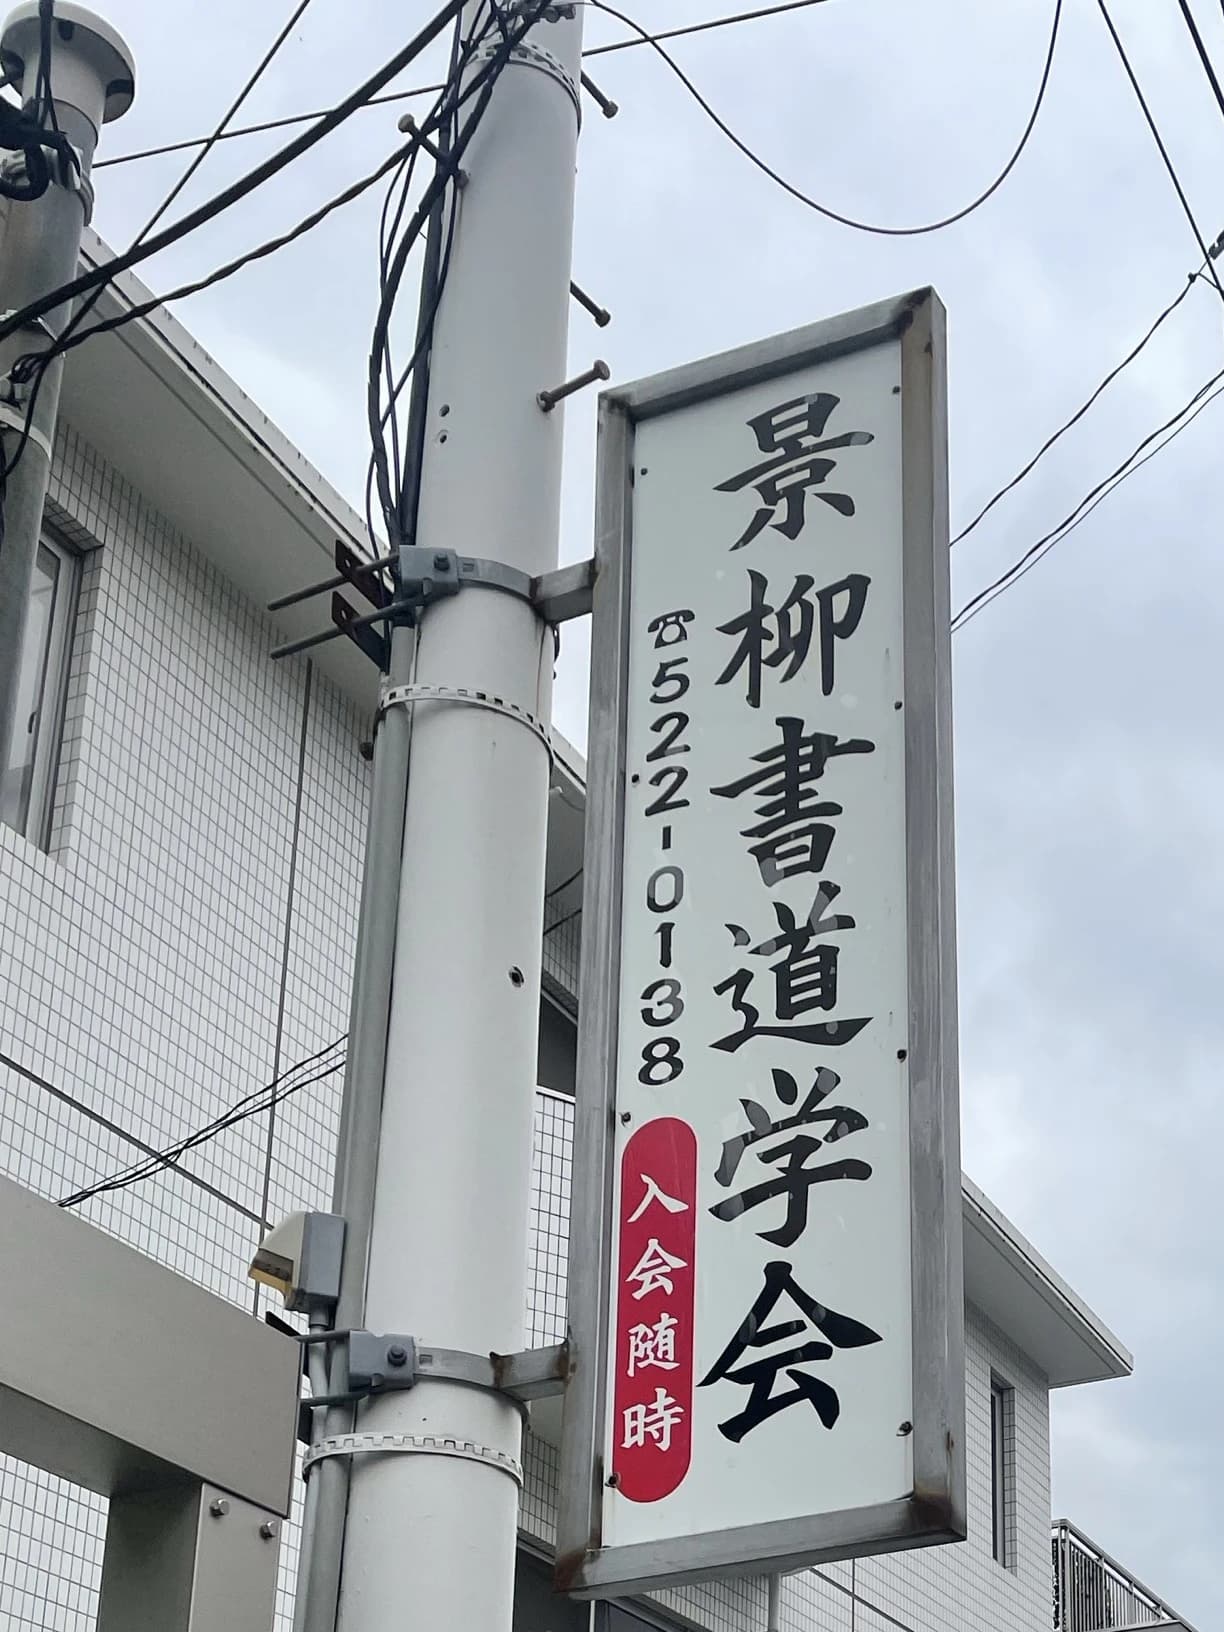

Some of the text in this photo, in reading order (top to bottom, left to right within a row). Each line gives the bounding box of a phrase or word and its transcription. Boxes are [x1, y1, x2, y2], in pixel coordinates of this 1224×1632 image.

[696, 393, 882, 1443] 景柳書道学会
[620, 1173, 689, 1451] 入会随時
